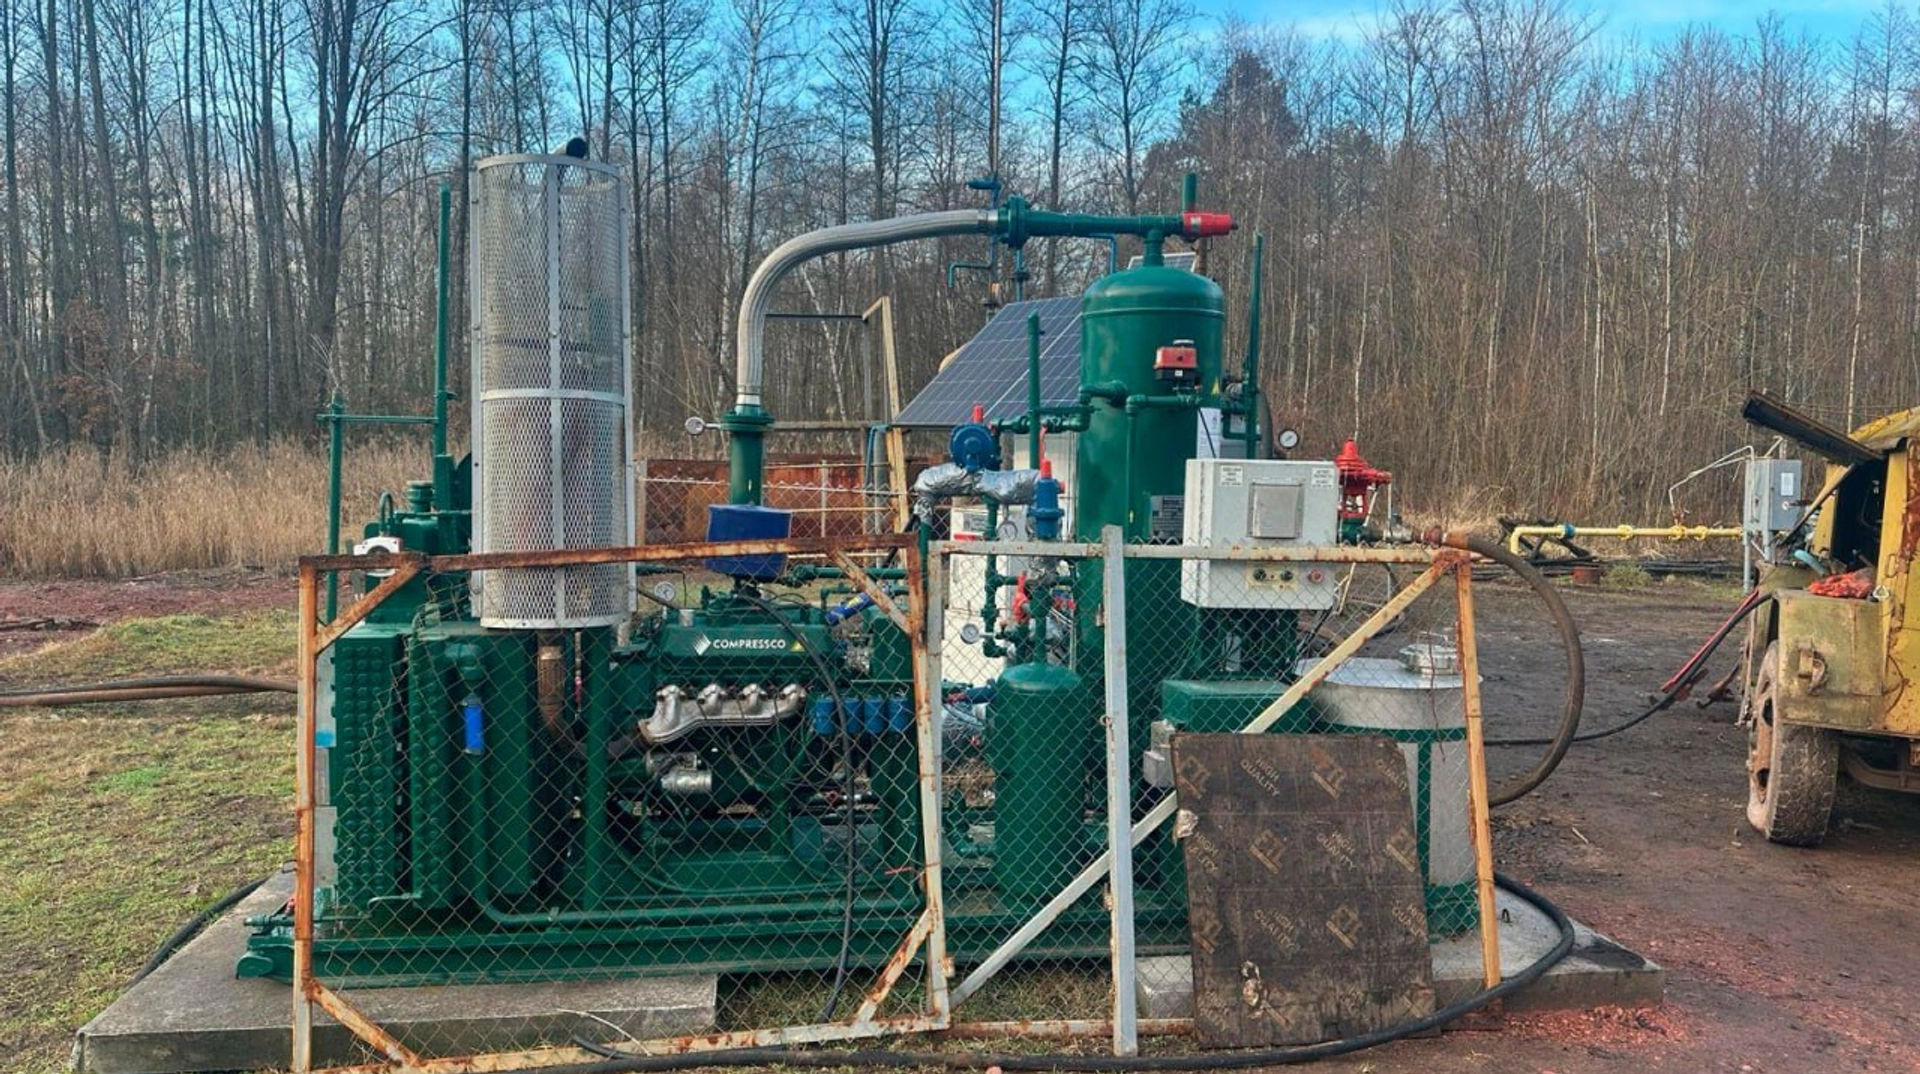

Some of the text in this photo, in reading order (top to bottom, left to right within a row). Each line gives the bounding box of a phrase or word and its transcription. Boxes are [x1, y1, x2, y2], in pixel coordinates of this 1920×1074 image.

[713, 639, 786, 649] COMPRESSCO
[1241, 760, 1280, 796] QUALITY
[1256, 759, 1279, 780] HIGH
[1254, 909, 1295, 948] QUALITY
